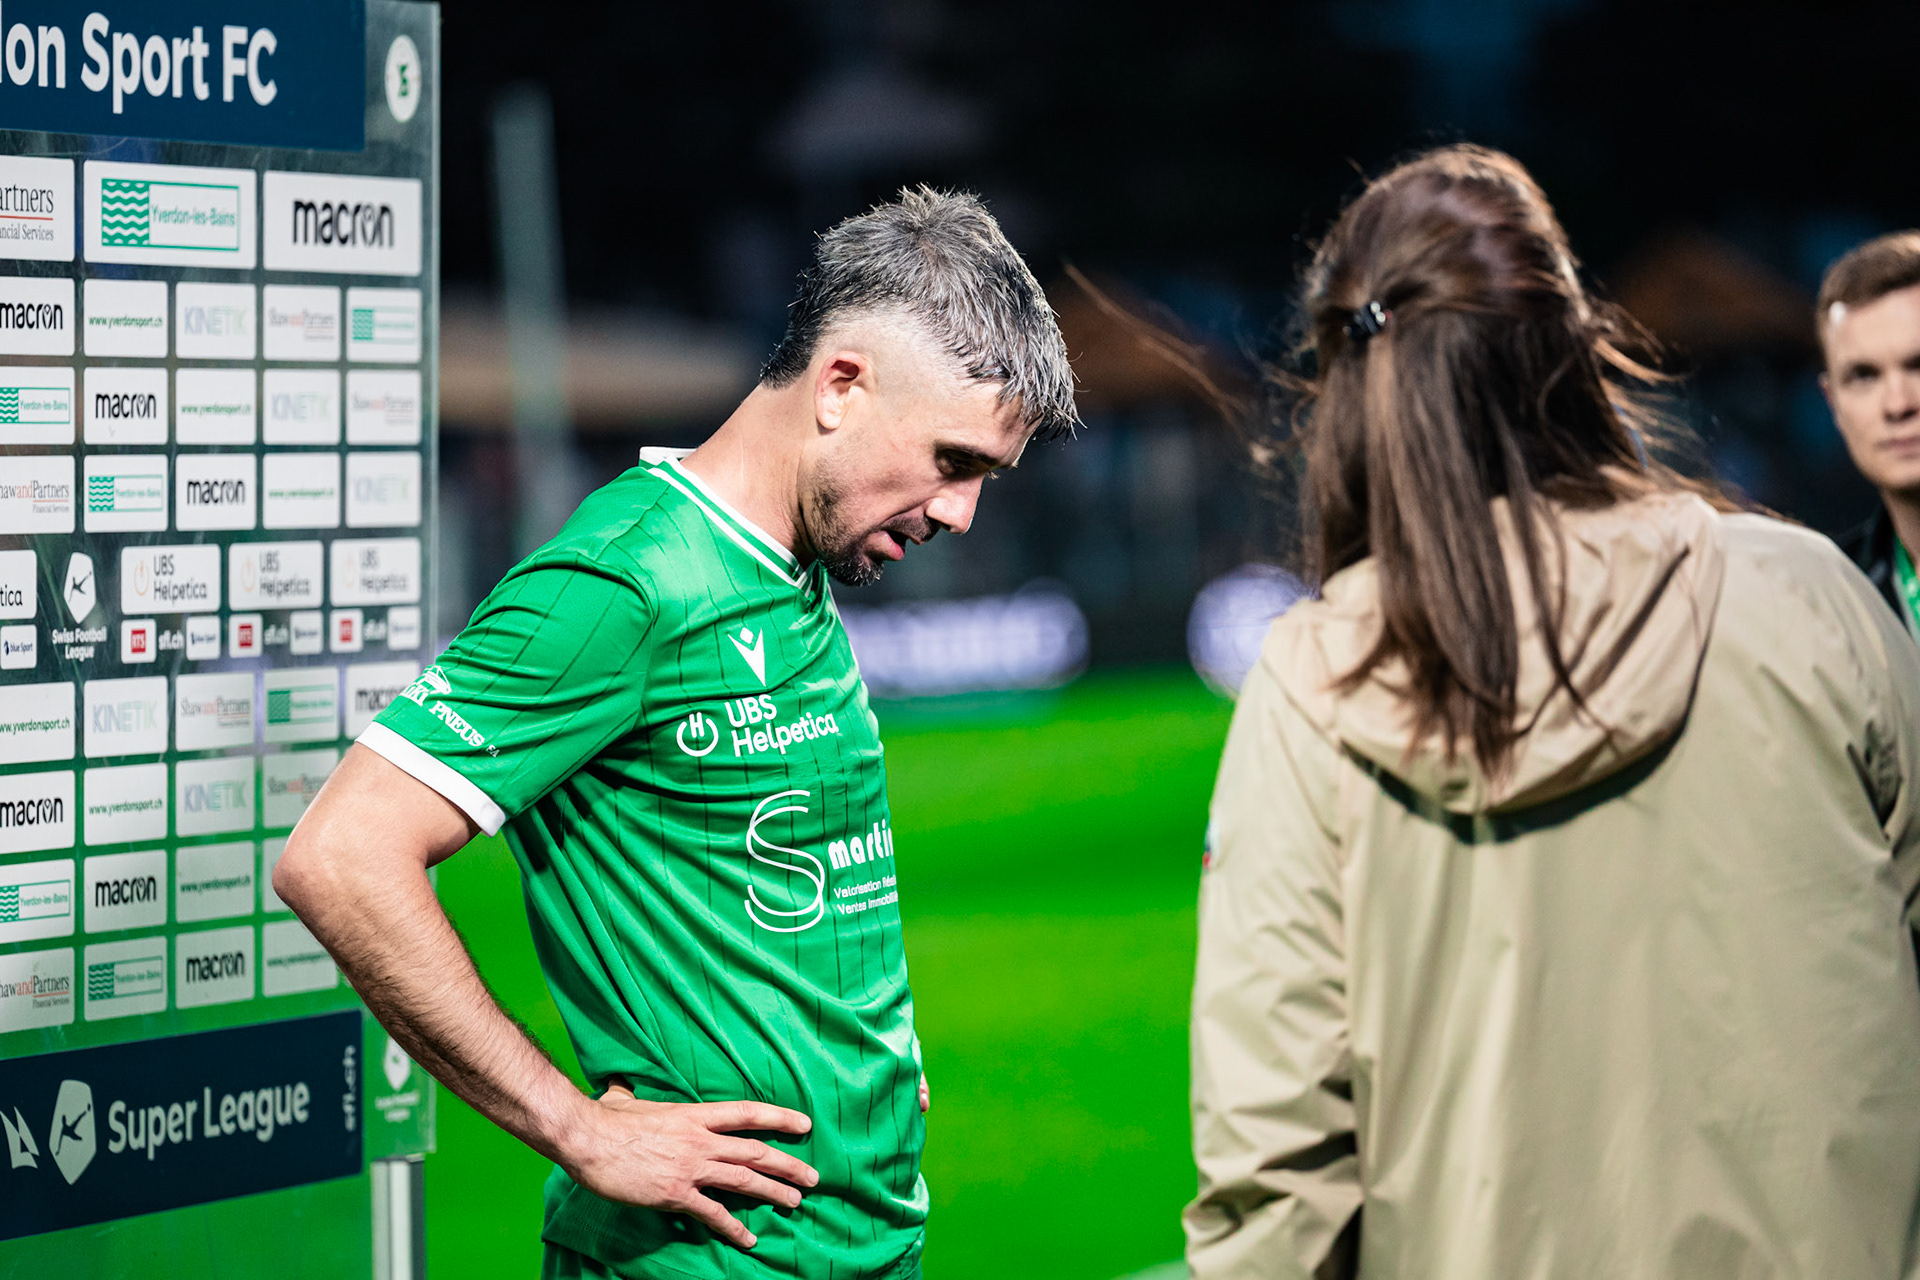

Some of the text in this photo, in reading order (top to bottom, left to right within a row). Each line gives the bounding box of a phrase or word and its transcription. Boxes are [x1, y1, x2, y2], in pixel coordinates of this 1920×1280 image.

[0, 0, 277, 115] on Sport FC
[150, 205, 236, 227] Yverdon-les-Bains
[292, 199, 395, 247] macron
[21, 224, 54, 241] Services
[0, 302, 63, 330] macron
[88, 314, 163, 329] www.yverdonsport.ch
[95, 394, 157, 419] macron
[186, 479, 245, 505] macron
[154, 555, 175, 576] UBS
[154, 577, 208, 604] Helpetica
[10, 642, 33, 654] blue Sport
[52, 626, 107, 645] Swiss Football
[158, 630, 184, 650] sfl.ch
[65, 645, 95, 662] League
[429, 700, 485, 747] PNEUS
[724, 694, 777, 728] UBS
[731, 712, 839, 757] Helpetica
[0, 798, 63, 828] macron
[88, 798, 163, 817] www.yverdonsport.ch
[95, 877, 157, 908] macron
[833, 880, 881, 899] Valorisation
[836, 901, 867, 915] Ventes
[186, 951, 245, 983] macron
[108, 1082, 310, 1161] Super League
